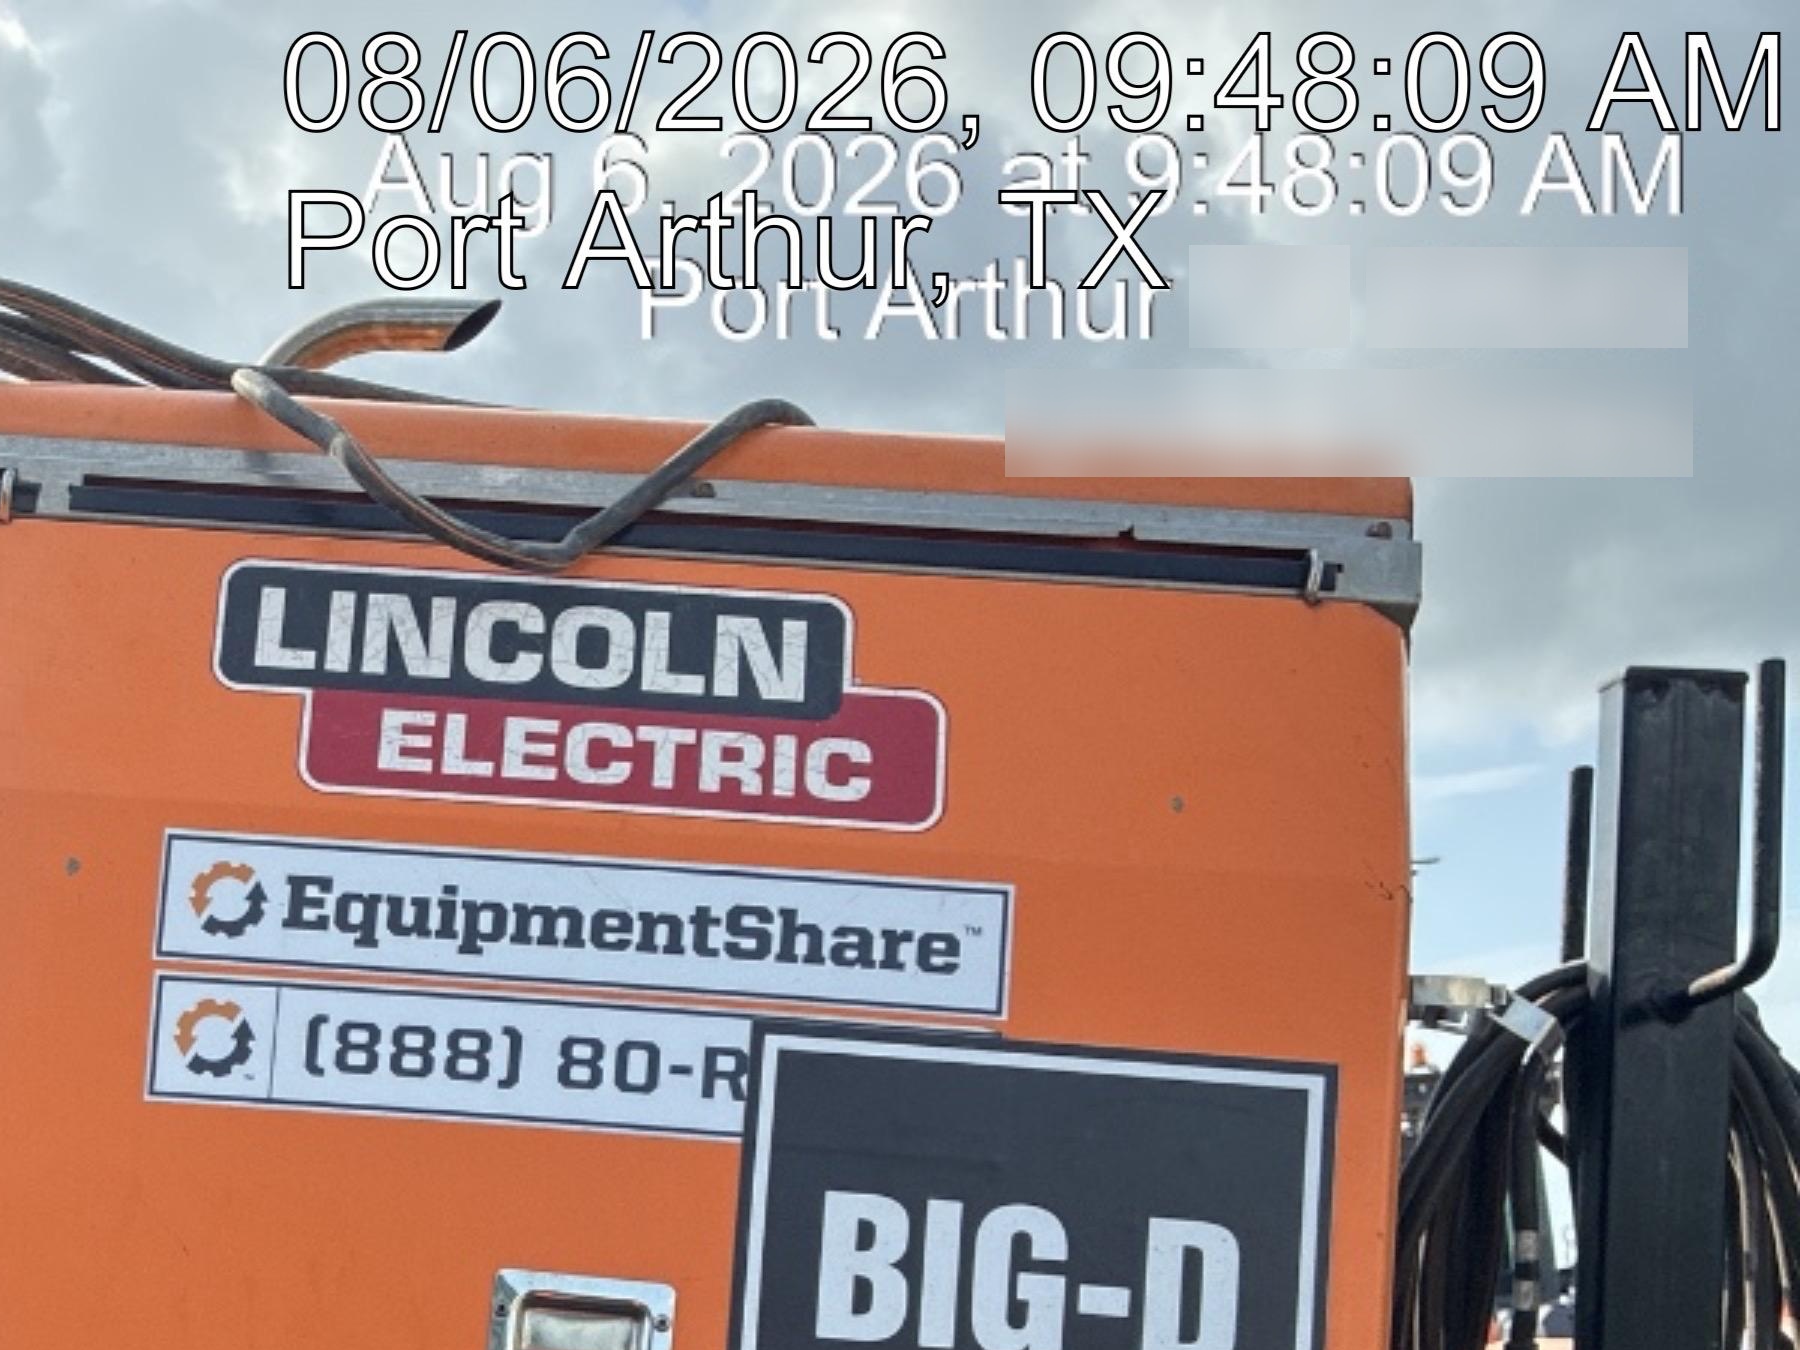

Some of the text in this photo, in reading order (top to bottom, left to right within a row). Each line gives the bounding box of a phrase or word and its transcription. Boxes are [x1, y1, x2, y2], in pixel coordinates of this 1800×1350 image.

[254, 585, 807, 703] LINCOLN
[377, 708, 873, 801] ELECTRIC
[304, 1012, 523, 1089] (888)
